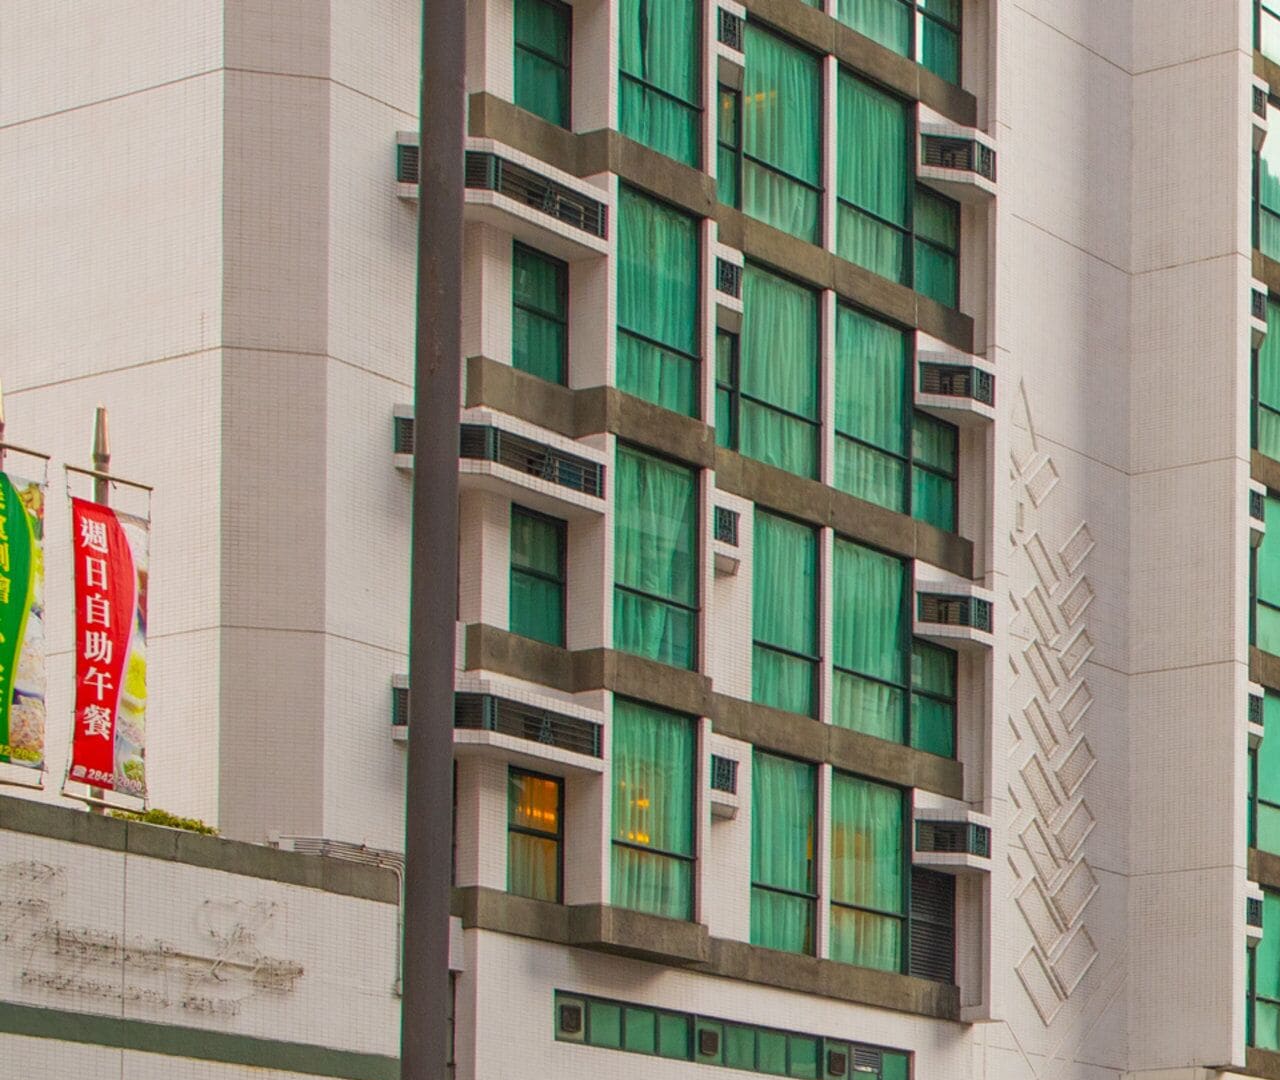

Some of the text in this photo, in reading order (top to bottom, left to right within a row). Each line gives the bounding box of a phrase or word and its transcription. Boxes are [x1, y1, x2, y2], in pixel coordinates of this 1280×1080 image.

[80, 516, 114, 741] 週日自助午餐
